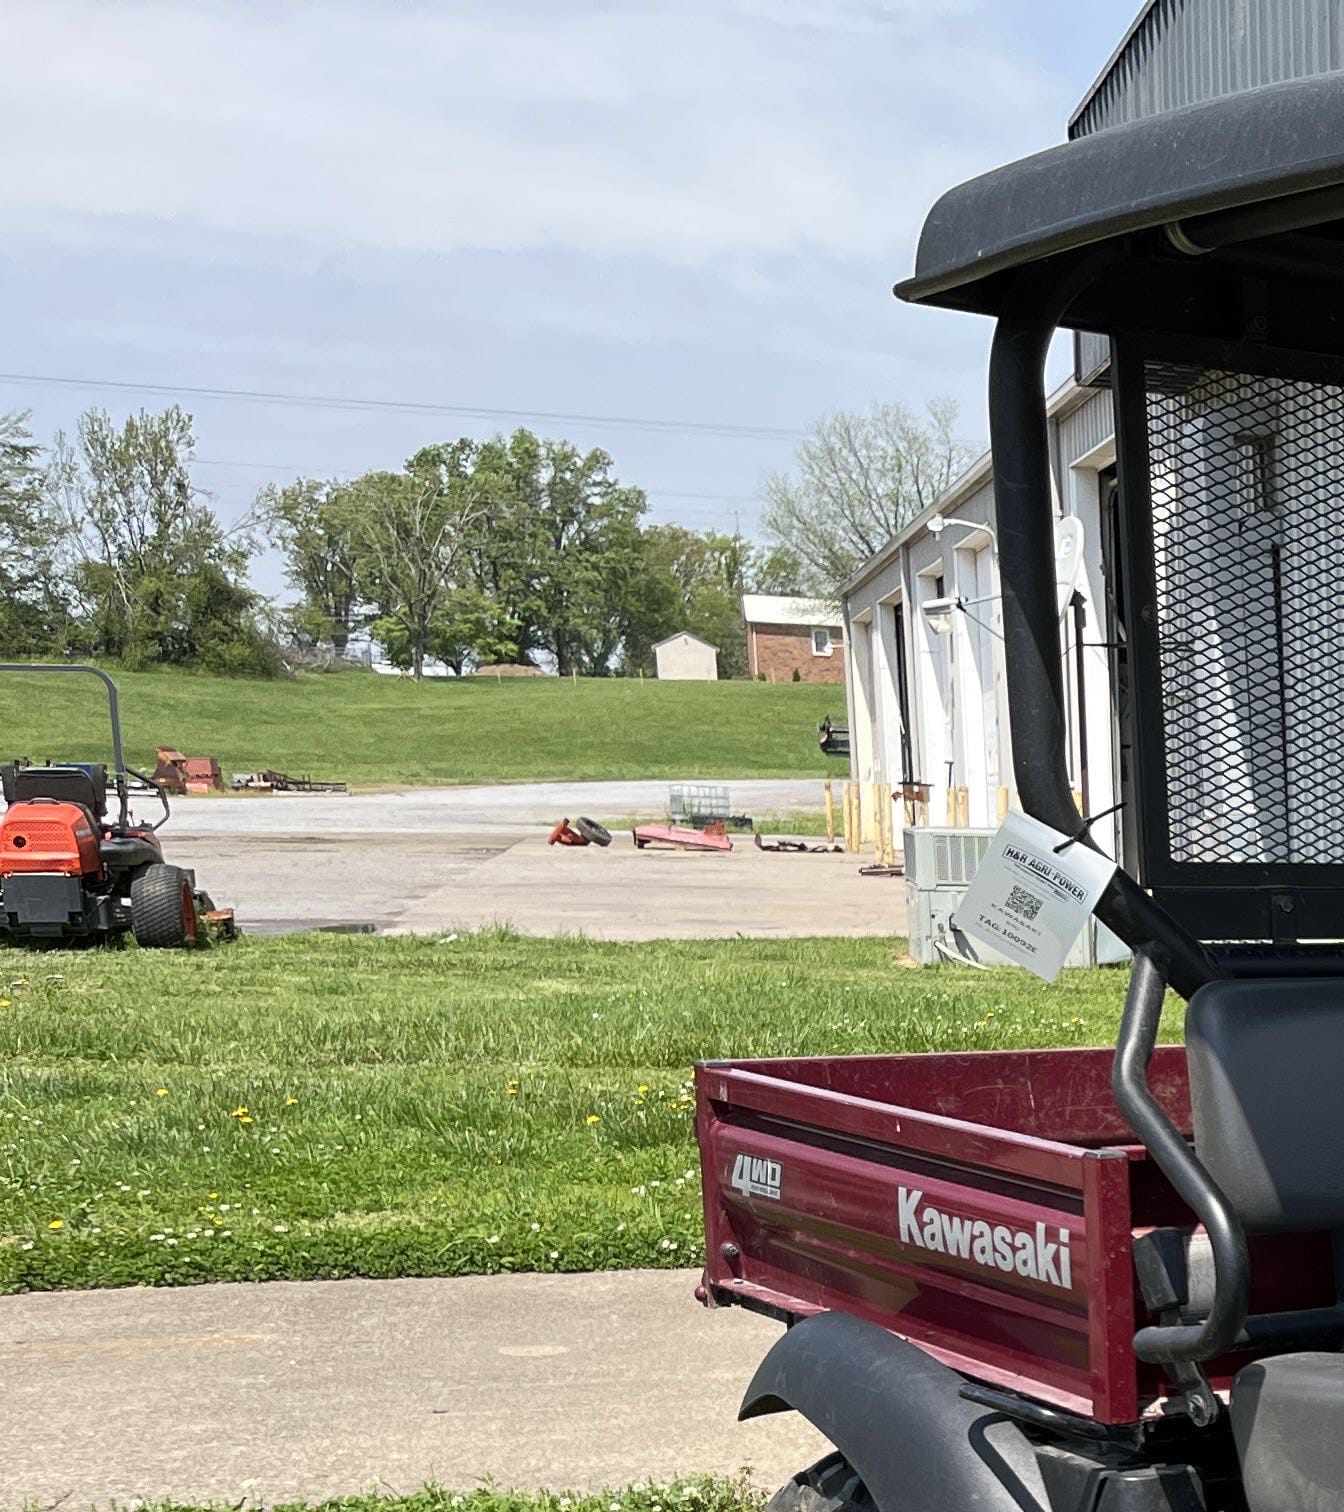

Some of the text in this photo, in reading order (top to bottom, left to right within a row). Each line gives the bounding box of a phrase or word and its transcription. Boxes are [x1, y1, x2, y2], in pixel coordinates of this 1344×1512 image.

[1006, 847, 1028, 863] H&R
[732, 1154, 781, 1197] 4WD
[897, 1187, 1072, 1290] Kawasaki
